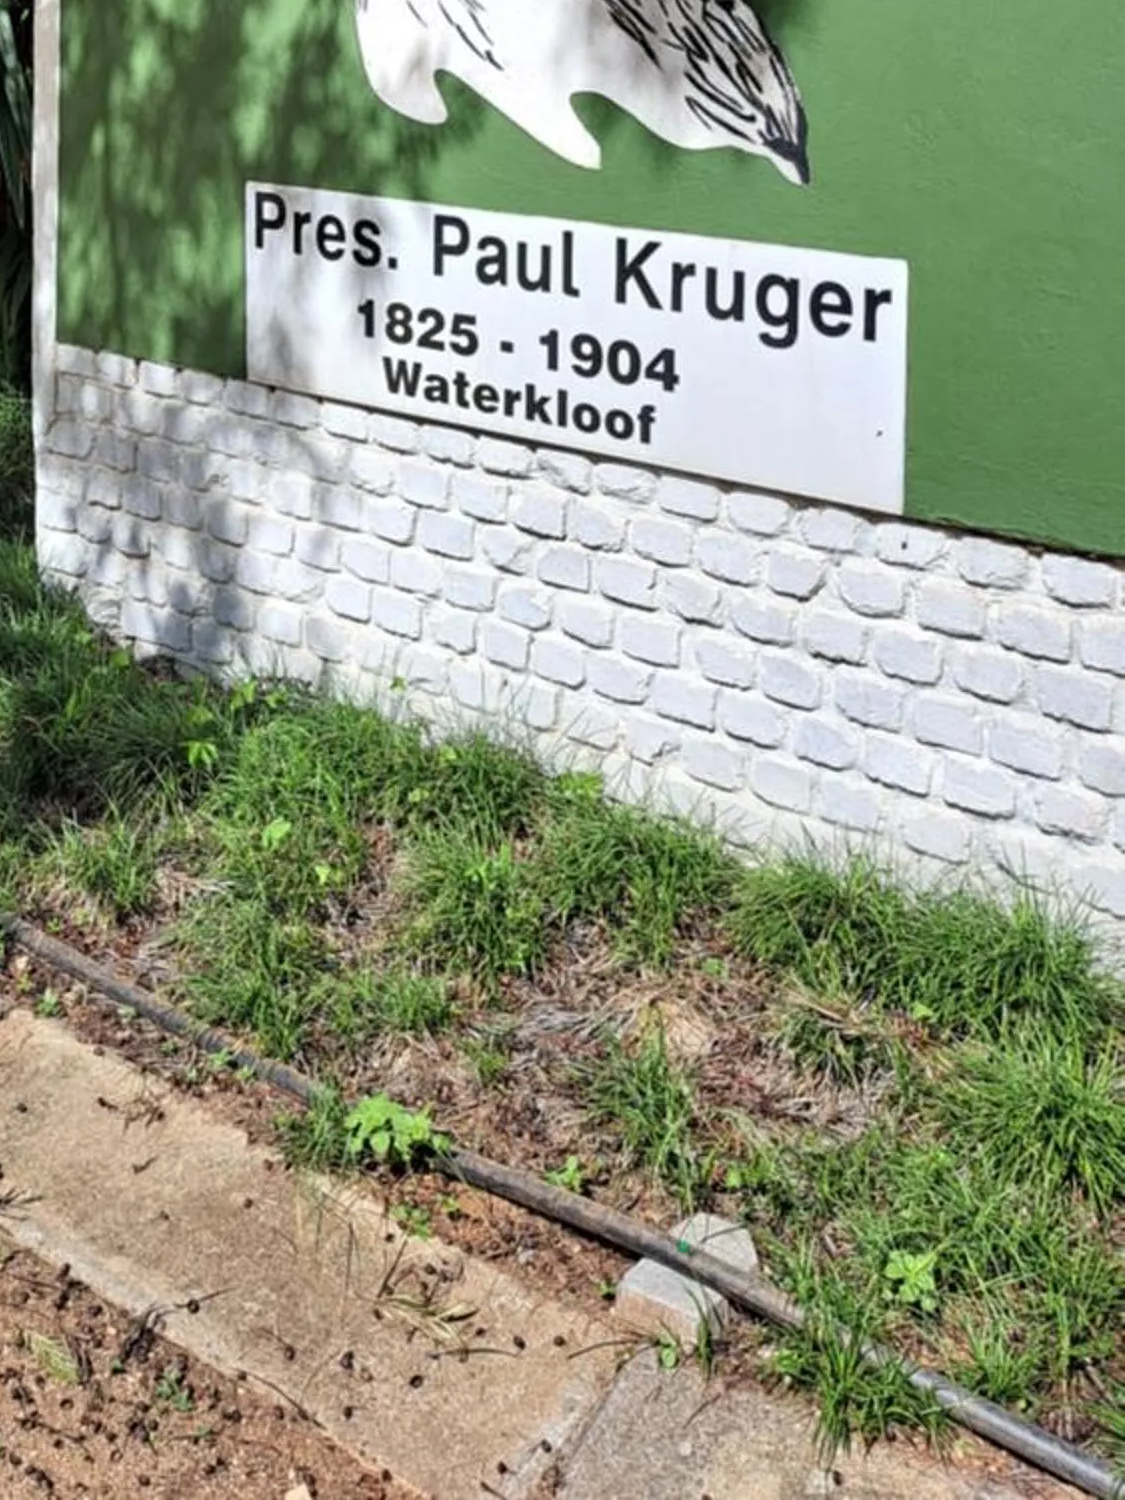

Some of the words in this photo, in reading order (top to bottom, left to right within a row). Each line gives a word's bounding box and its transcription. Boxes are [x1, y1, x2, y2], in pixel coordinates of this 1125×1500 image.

[254, 191, 398, 271] Pres.
[432, 214, 580, 297] Paul
[614, 237, 892, 349] Kruger
[357, 299, 479, 357] 1825
[538, 329, 680, 392] 1904
[382, 356, 656, 444] Waterkloof
